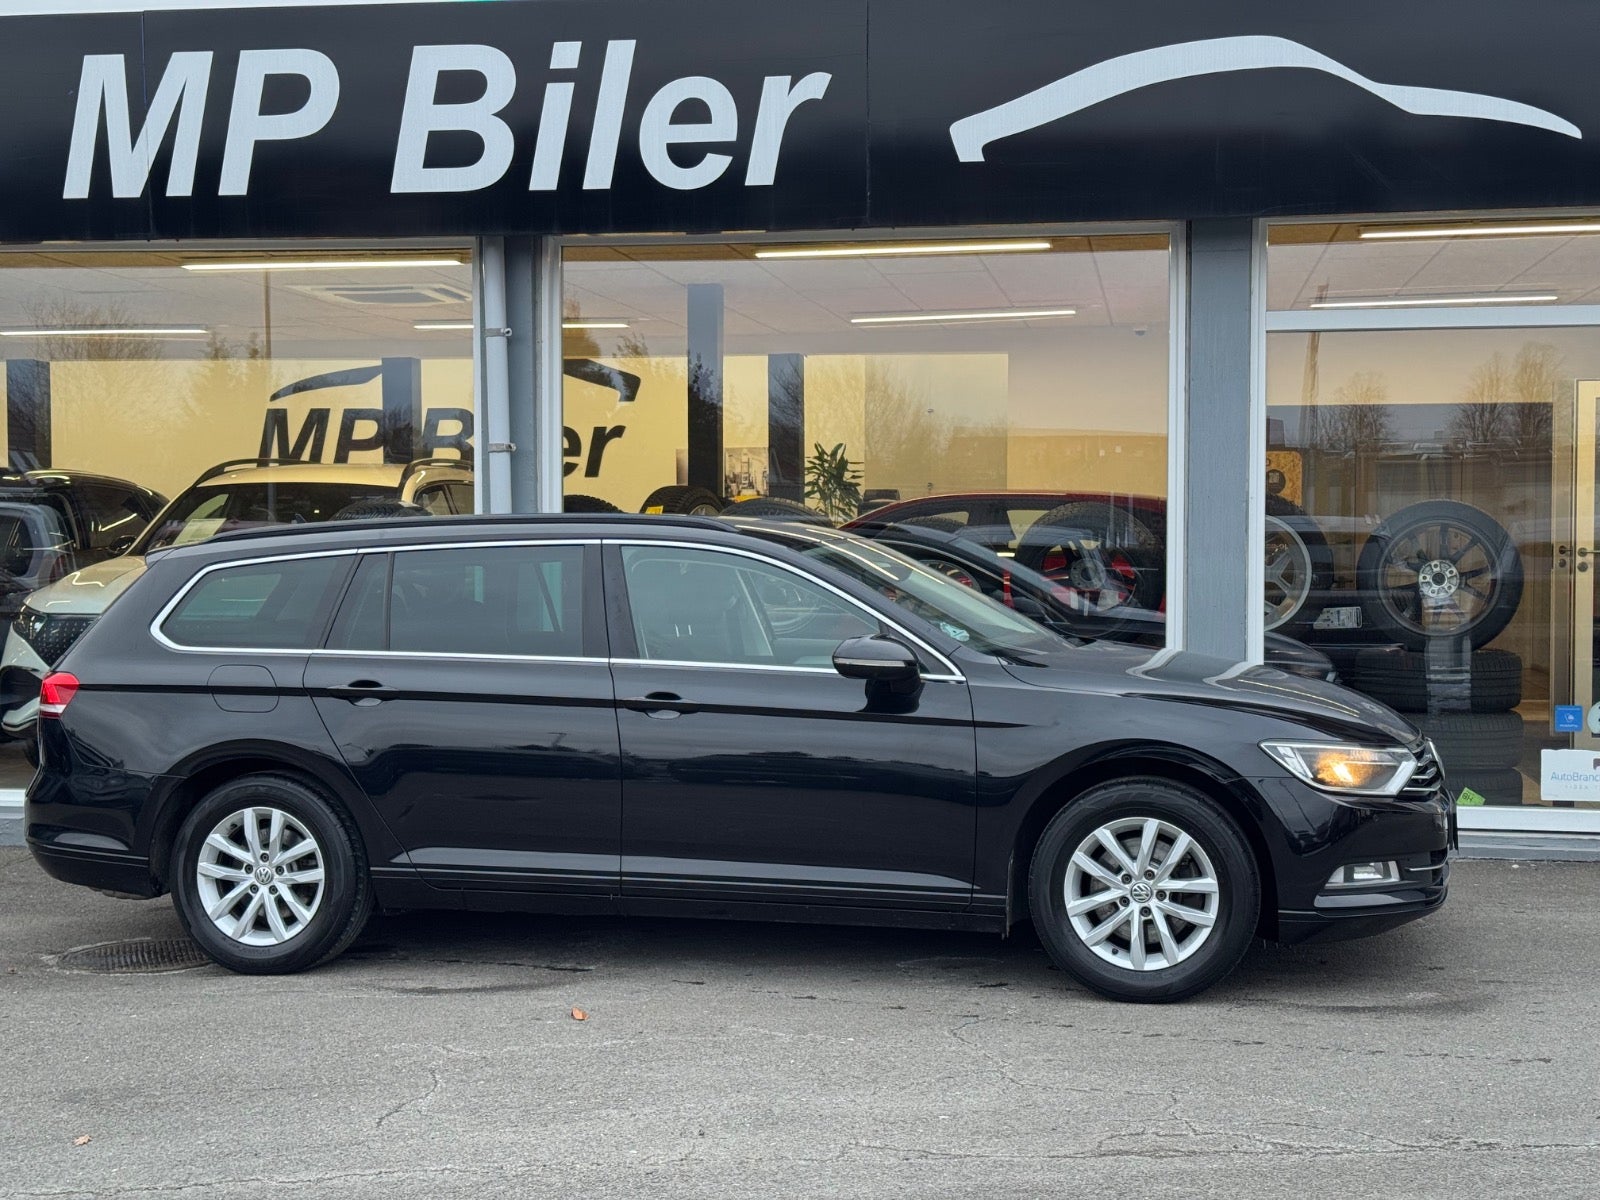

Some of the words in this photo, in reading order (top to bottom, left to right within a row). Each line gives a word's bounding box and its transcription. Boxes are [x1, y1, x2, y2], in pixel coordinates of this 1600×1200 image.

[63, 48, 340, 199] MP
[390, 39, 833, 194] Biler
[257, 407, 384, 467] MP
